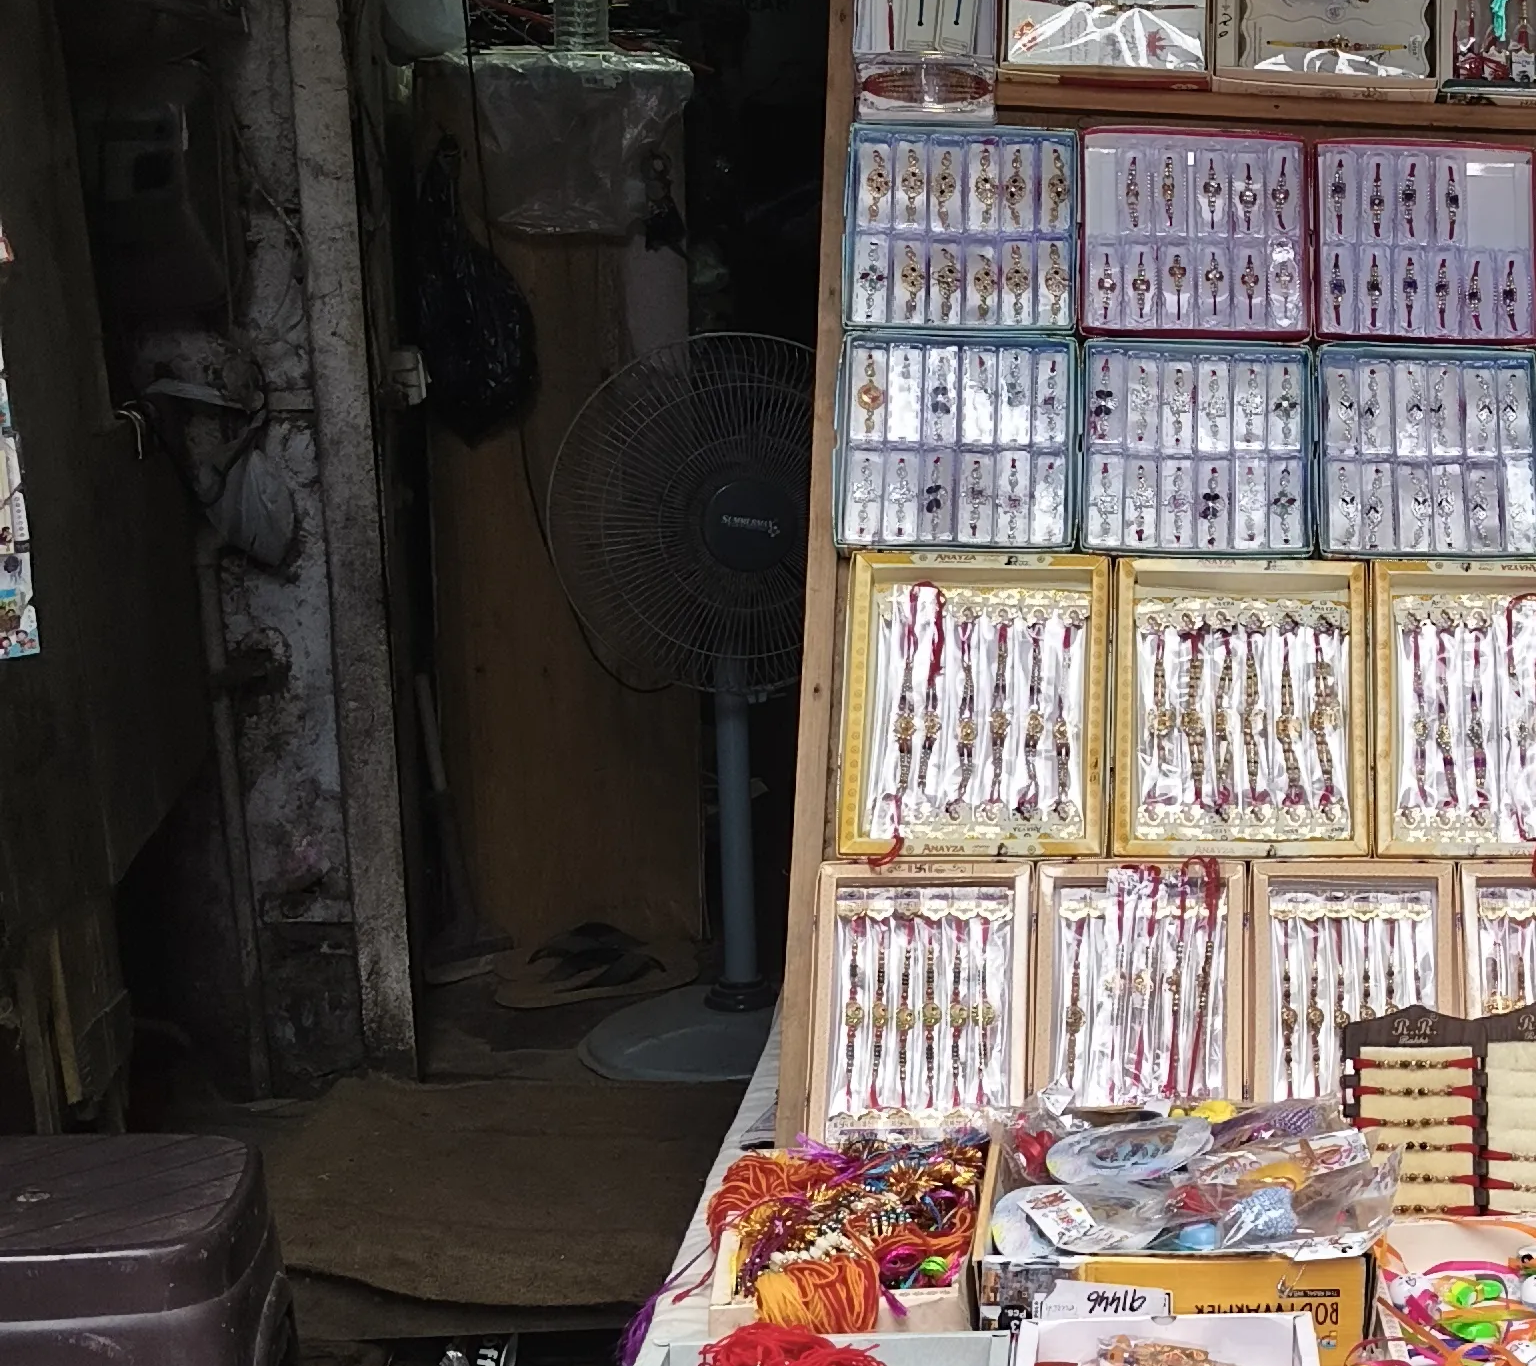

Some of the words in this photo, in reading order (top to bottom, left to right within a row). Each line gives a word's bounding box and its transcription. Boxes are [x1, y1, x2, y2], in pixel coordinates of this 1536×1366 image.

[1391, 1018, 1438, 1035] R.R.
[1086, 1288, 1147, 1315] 91446
[1011, 1320, 1021, 1334] 3
